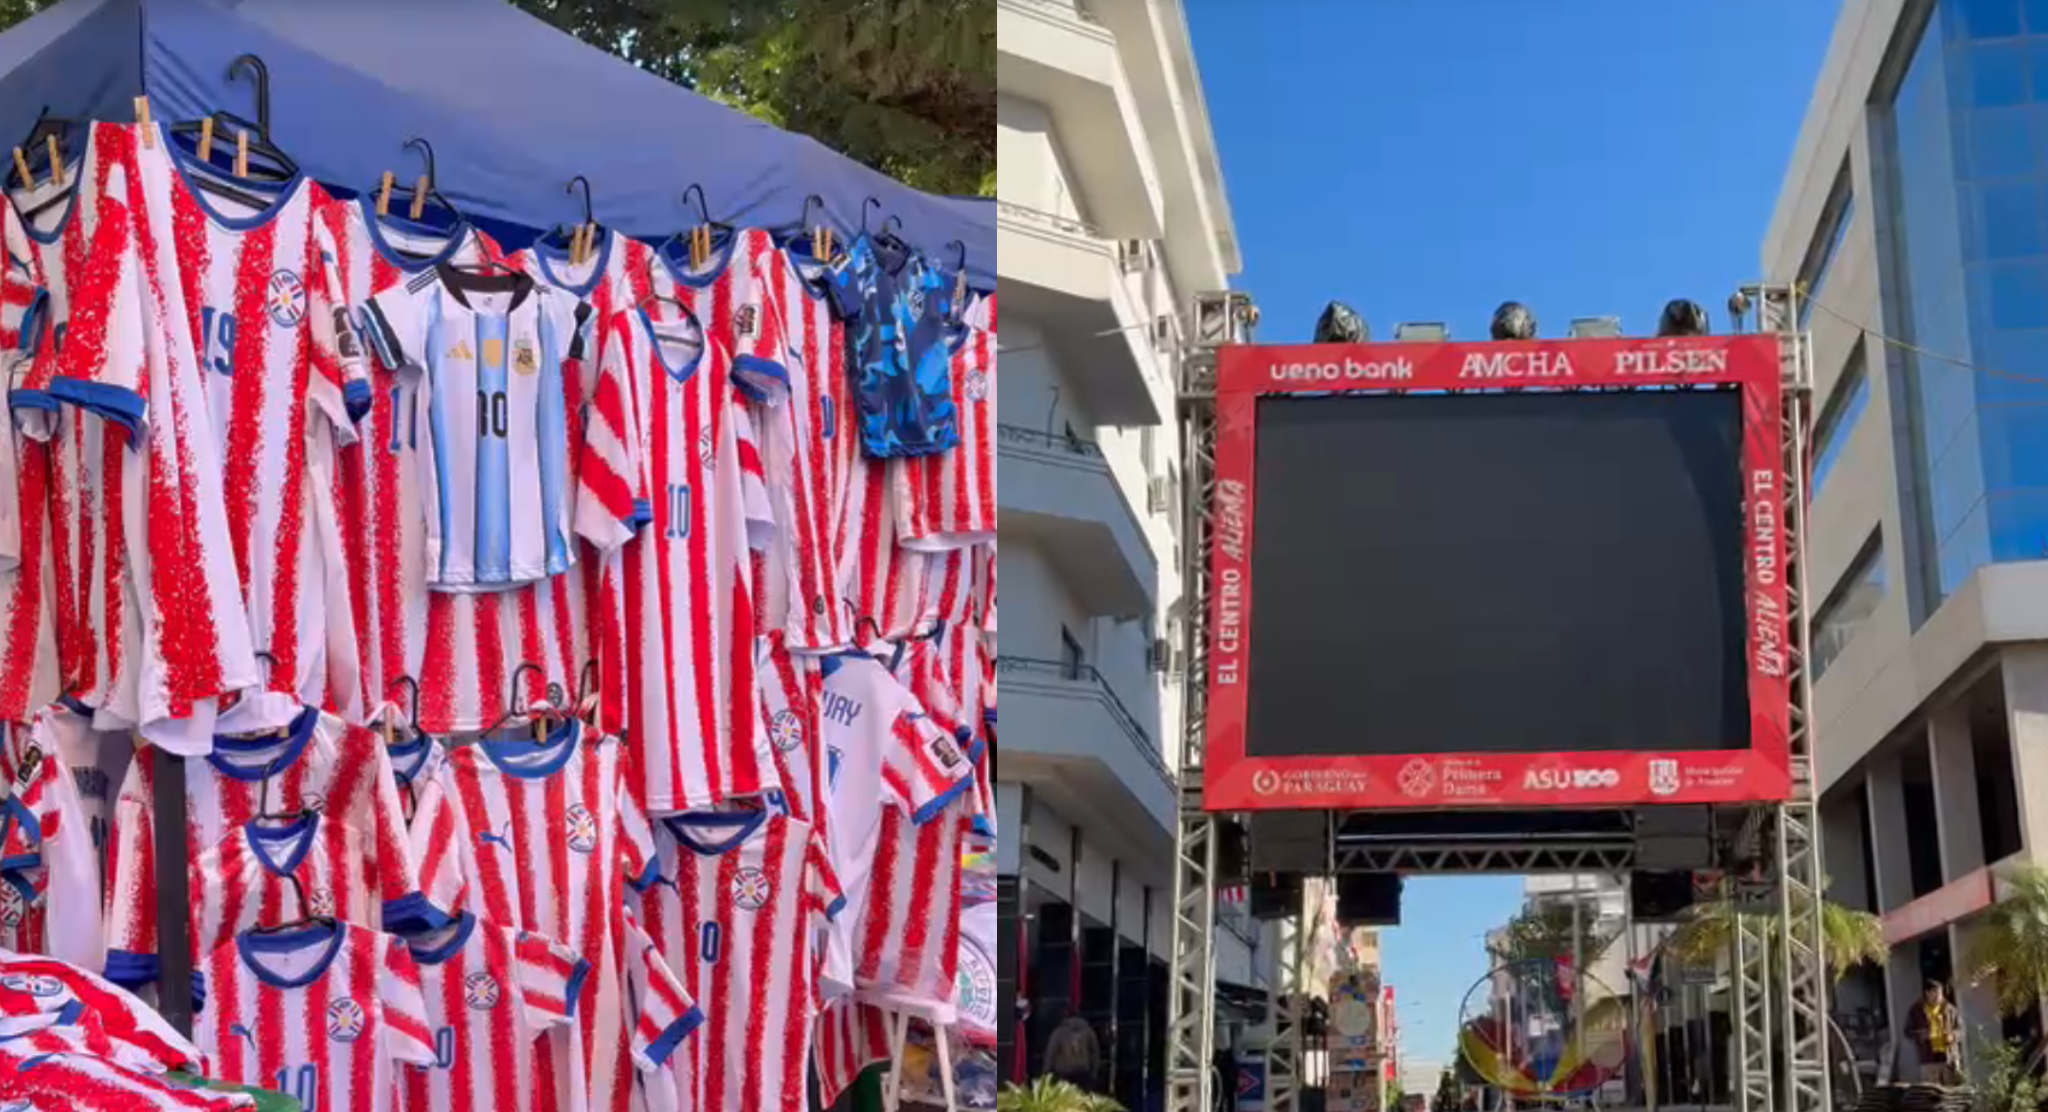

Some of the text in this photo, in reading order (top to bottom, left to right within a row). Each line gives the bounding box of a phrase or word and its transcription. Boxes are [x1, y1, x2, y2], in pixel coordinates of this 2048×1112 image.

[1270, 356, 1413, 381] ueno bank
[1458, 350, 1574, 379] AMCHA
[1613, 348, 1729, 375] PILSEN
[477, 388, 507, 438] 10
[1753, 469, 1774, 495] EL
[667, 483, 691, 539] 10
[1755, 500, 1776, 585] CENTRO
[1219, 568, 1241, 653] CENTRO
[1218, 659, 1239, 684] EL
[1282, 779, 1368, 795] PARAGUAY
